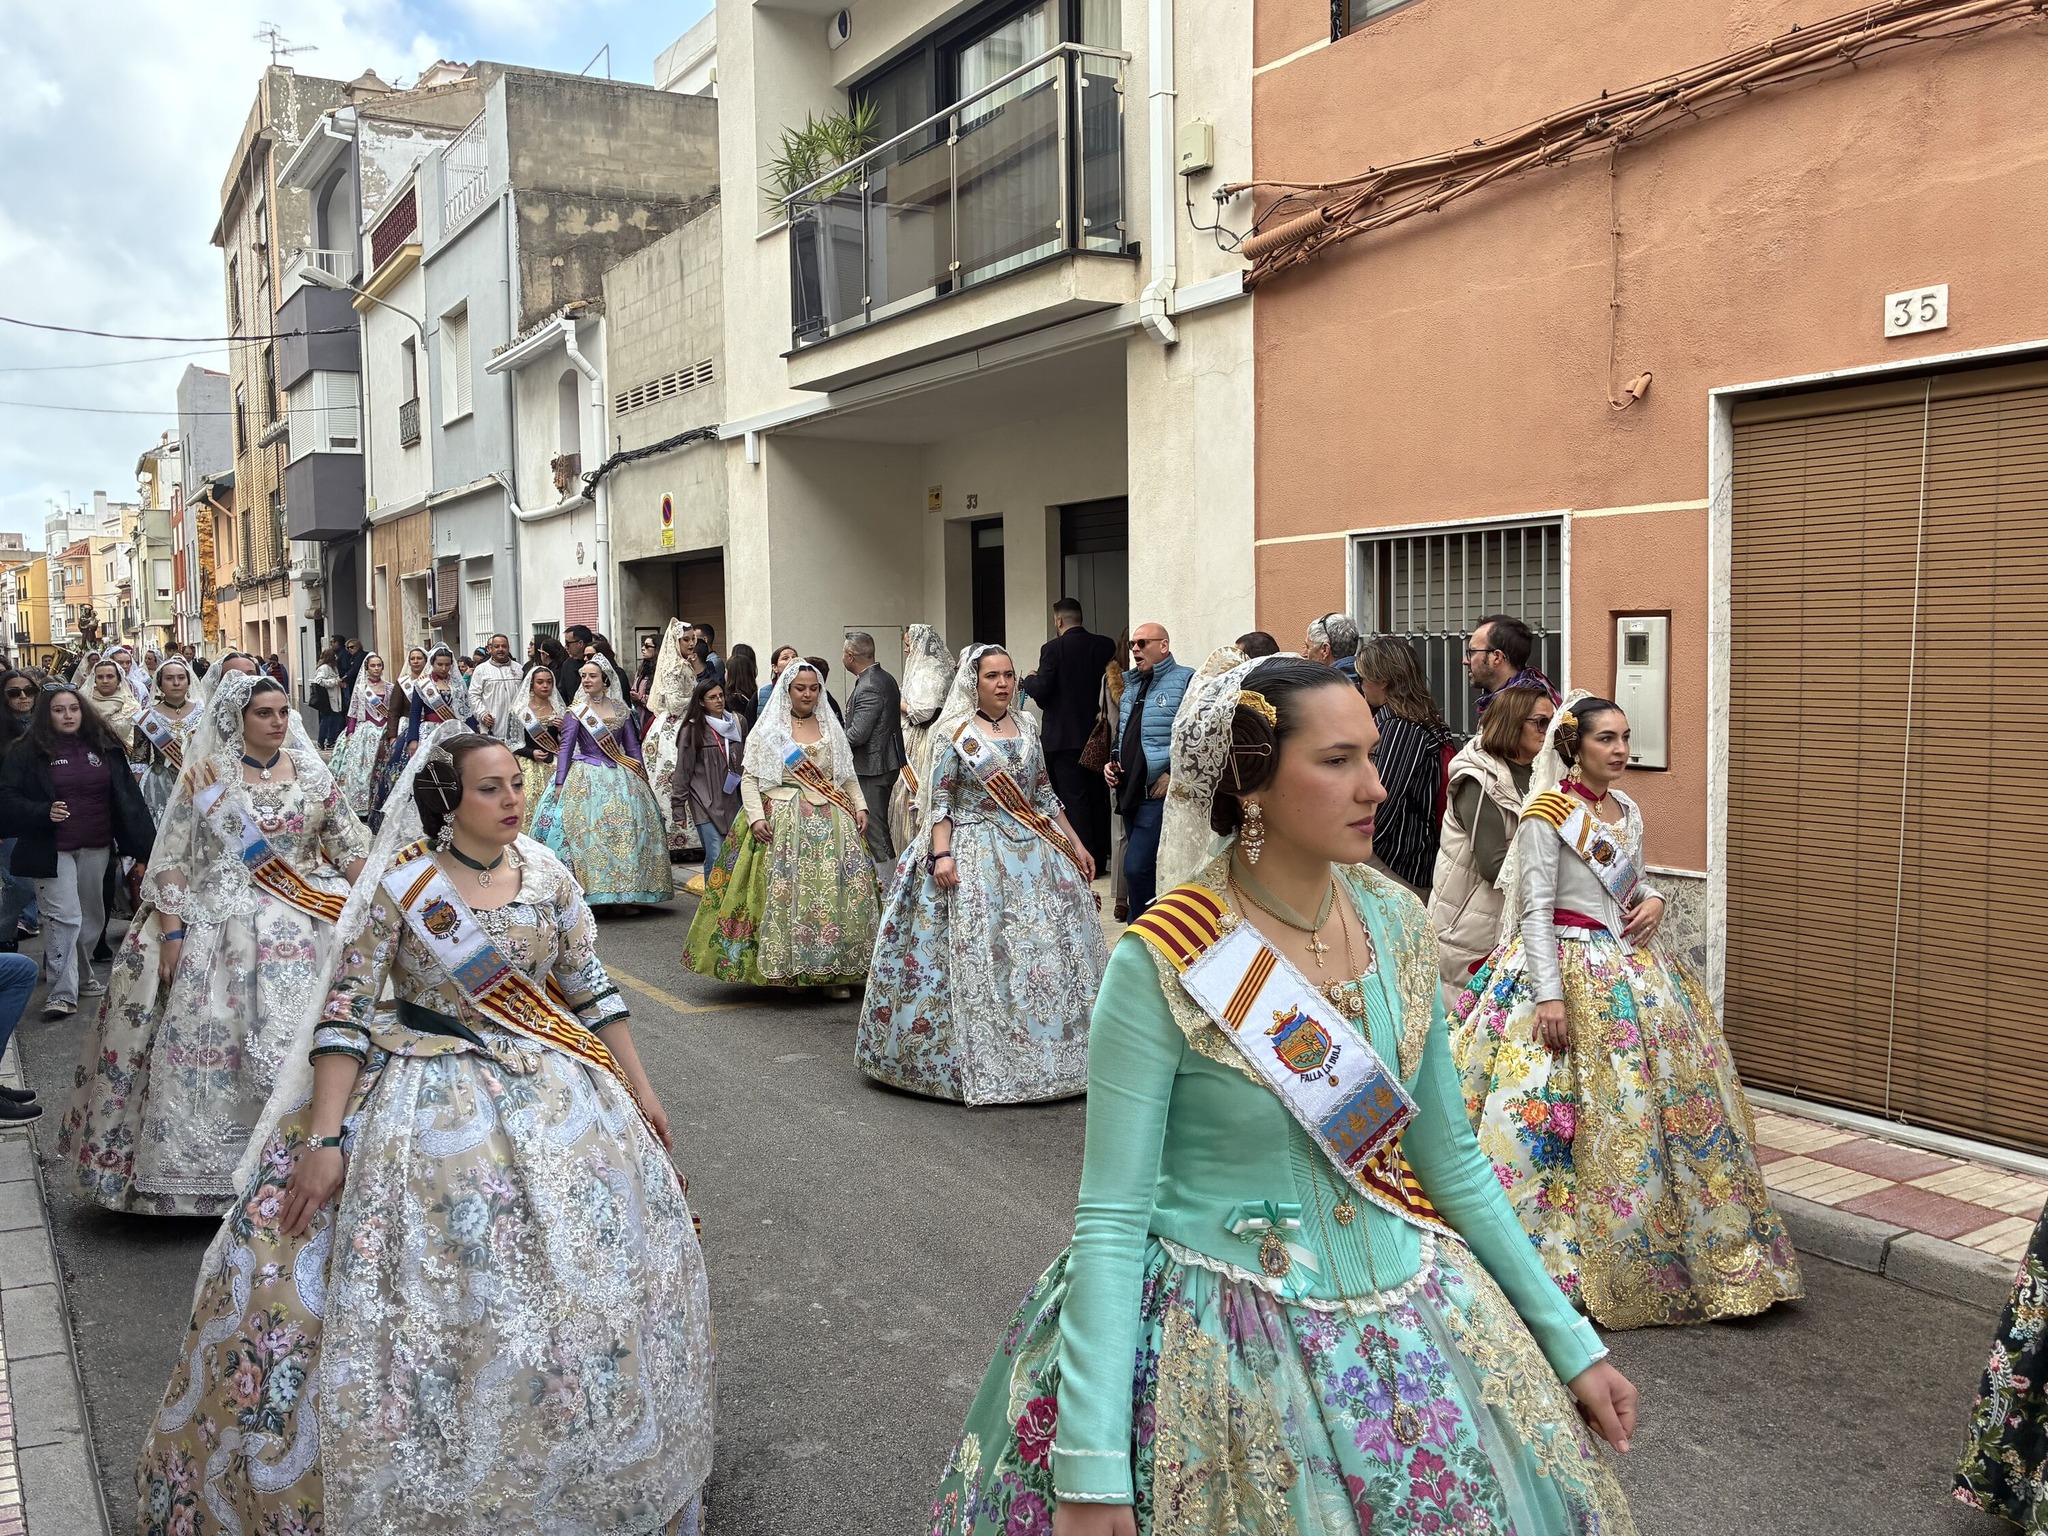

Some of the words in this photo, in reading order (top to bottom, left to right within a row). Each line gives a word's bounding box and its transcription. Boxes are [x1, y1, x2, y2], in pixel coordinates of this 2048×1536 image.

[1894, 293, 1937, 327] 35
[966, 493, 978, 509] 33
[1300, 1070, 1324, 1084] FALLA
[1322, 1063, 1334, 1075] LA
[1328, 1044, 1343, 1066] DULA
